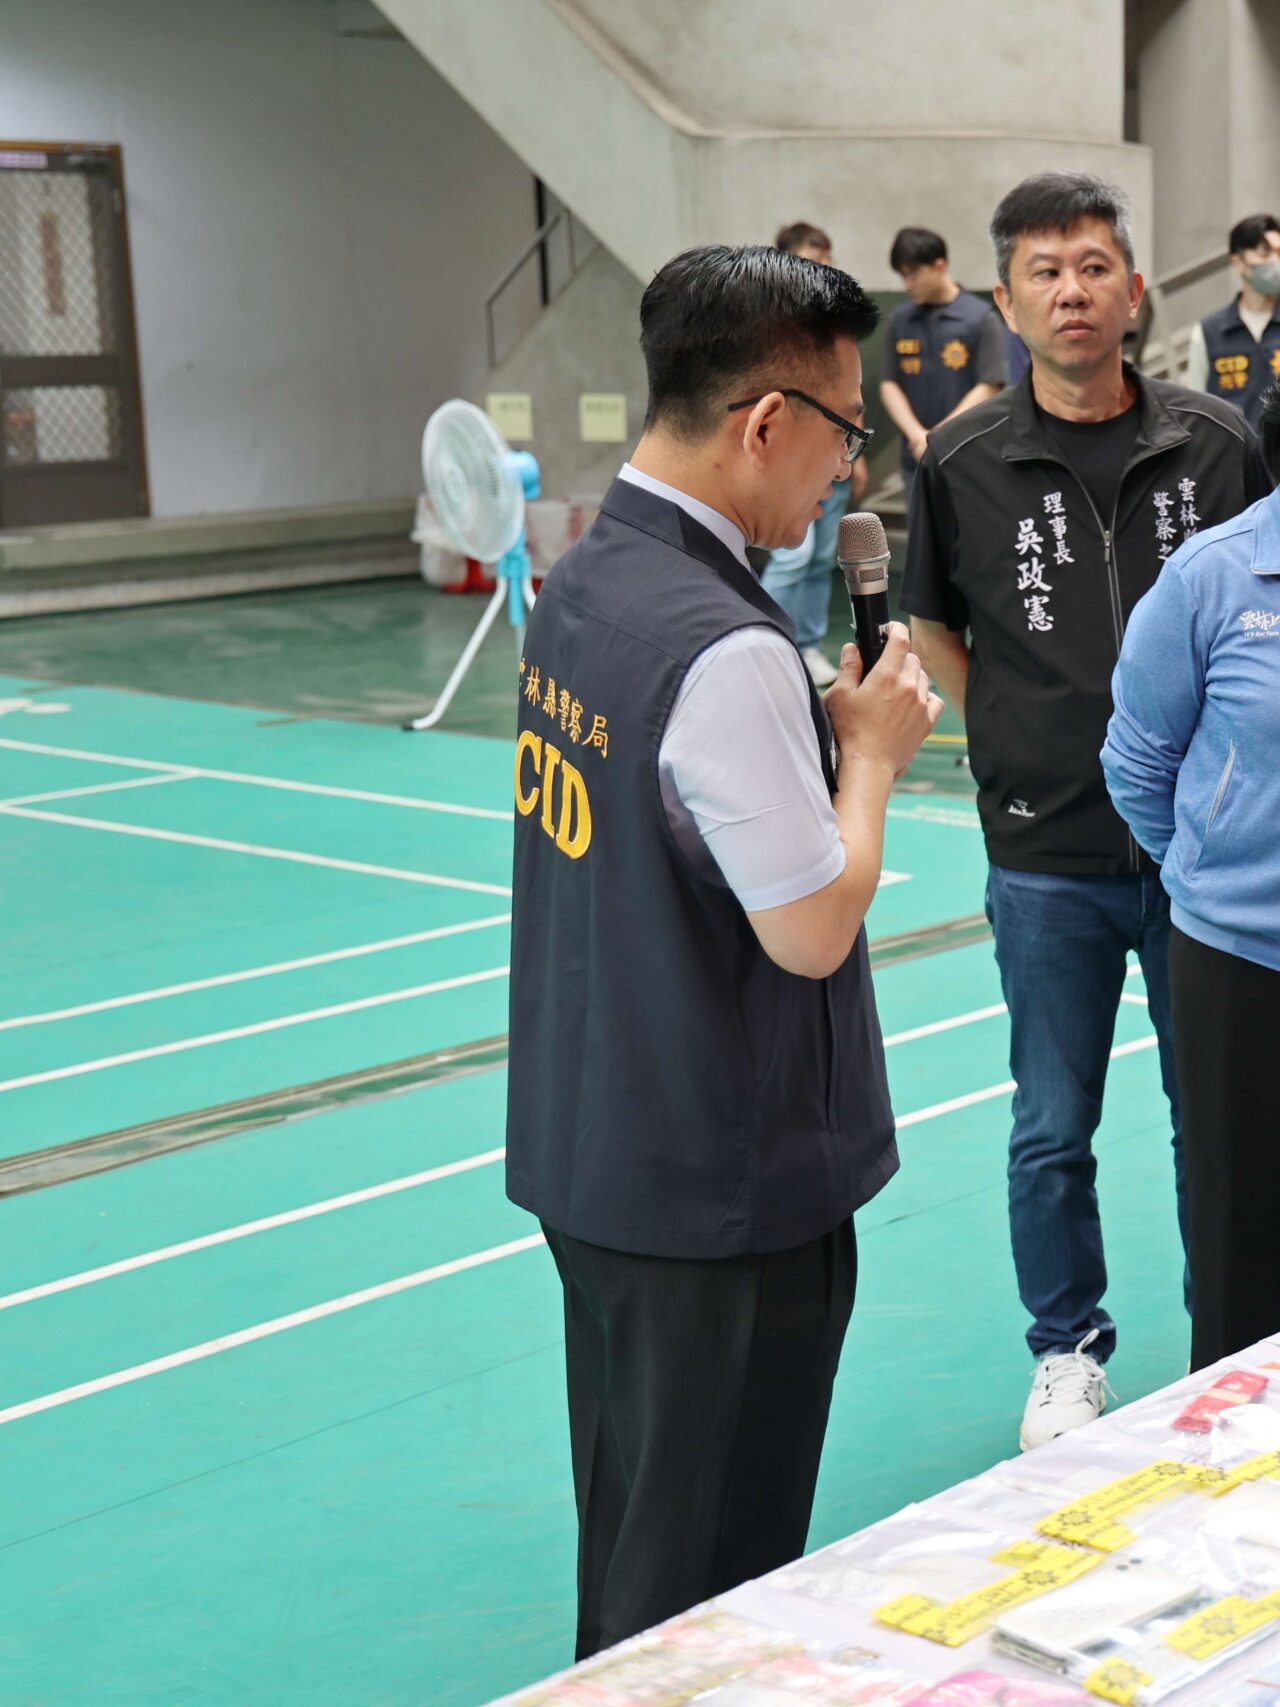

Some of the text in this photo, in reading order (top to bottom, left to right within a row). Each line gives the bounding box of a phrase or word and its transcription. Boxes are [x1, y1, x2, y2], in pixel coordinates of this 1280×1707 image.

[1014, 518, 1054, 632] 吳政憲
[1043, 491, 1075, 565] 理事長
[519, 658, 609, 758] 林縣警察局
[514, 730, 592, 860] CID
